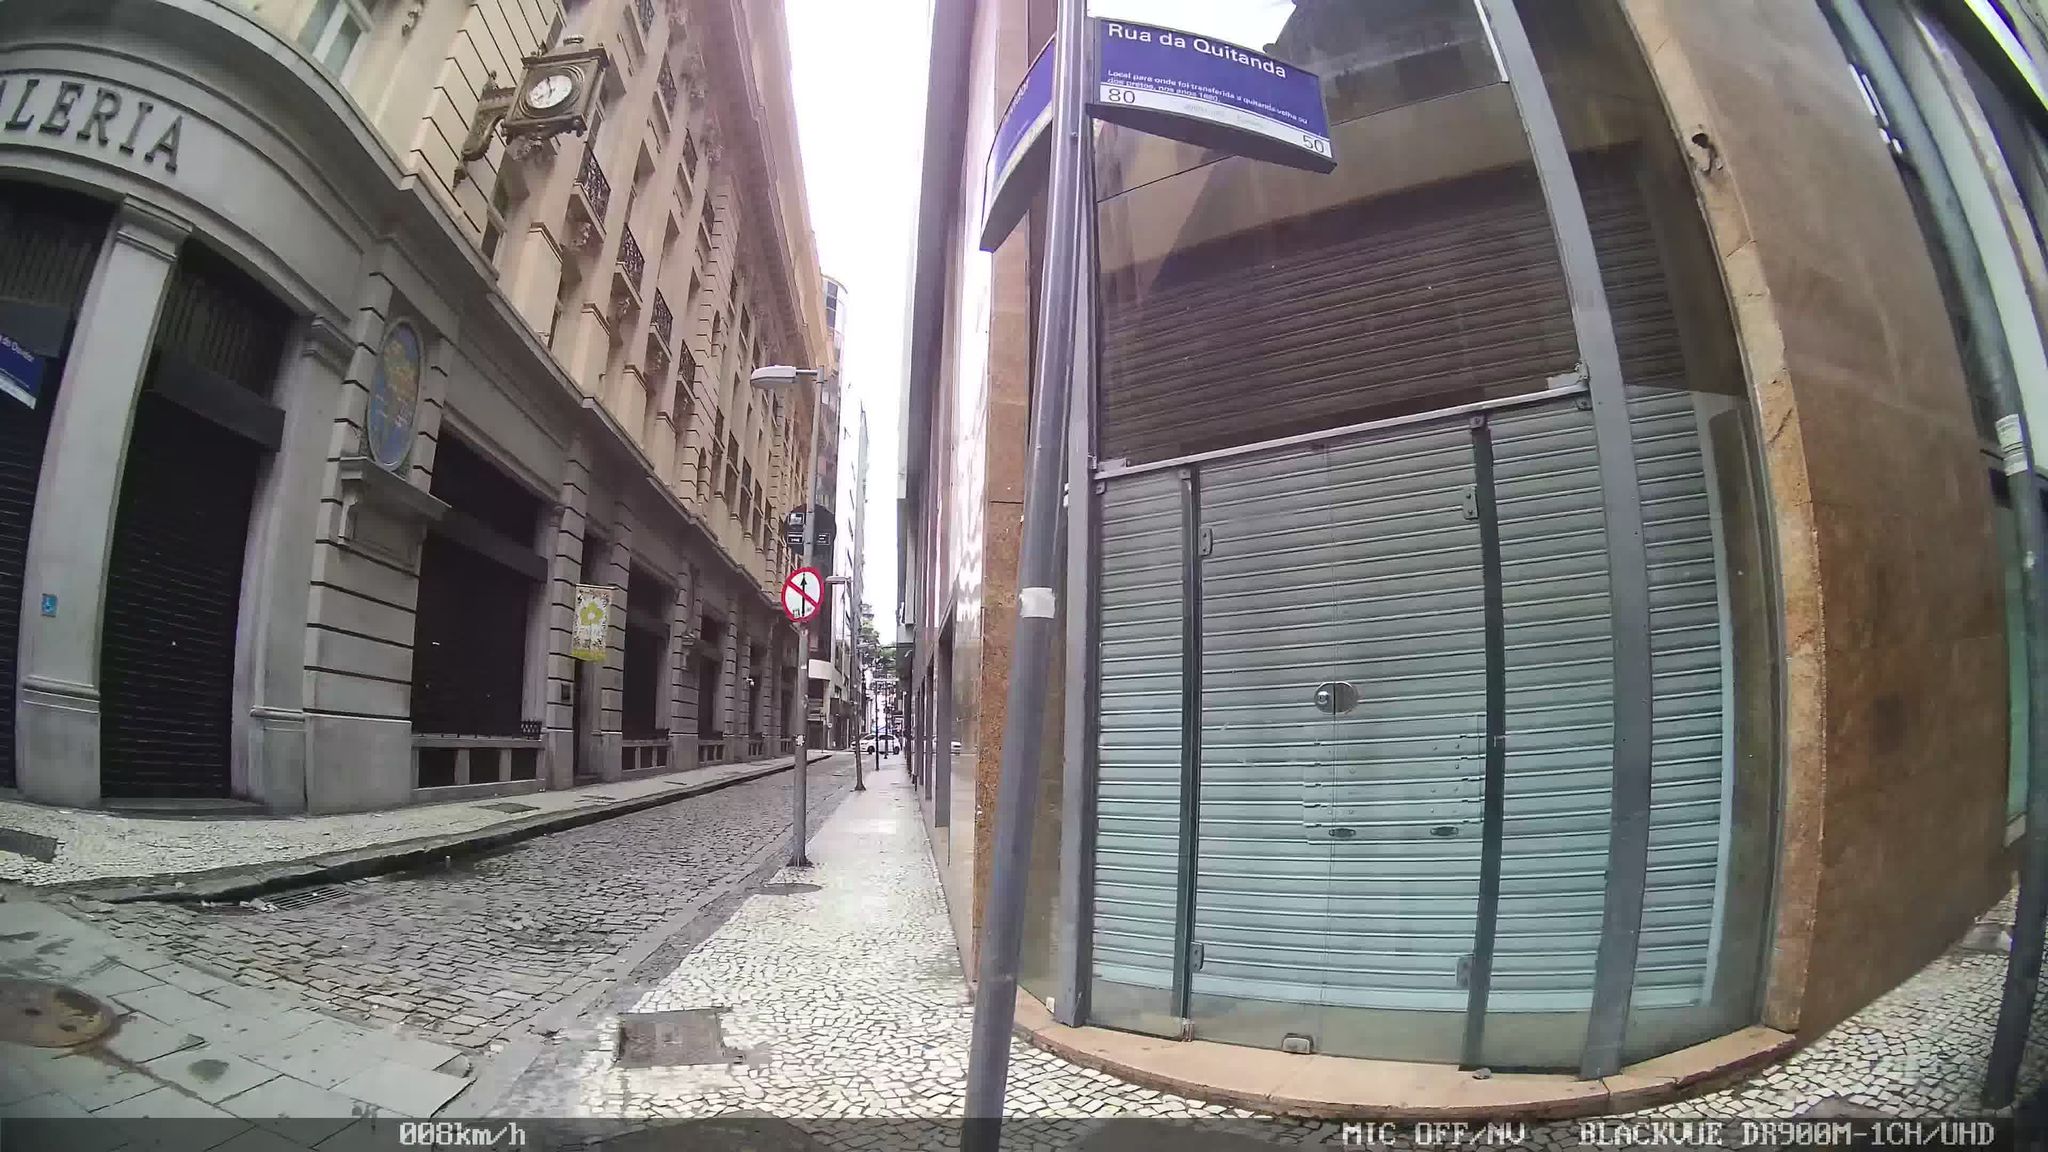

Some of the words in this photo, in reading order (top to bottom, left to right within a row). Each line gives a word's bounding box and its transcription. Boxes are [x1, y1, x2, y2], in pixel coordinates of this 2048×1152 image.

[1108, 23, 1152, 42] Rua
[1159, 33, 1186, 48] da
[1193, 38, 1287, 78] Quitanda
[1107, 69, 1131, 78] Local
[1132, 74, 1153, 82] para
[1154, 78, 1177, 86] onde
[1191, 84, 1235, 99] transferida
[1243, 97, 1276, 112] quitanda
[1108, 88, 1136, 104] 80
[0, 79, 183, 173] LERIA
[1303, 134, 1324, 153] 50
